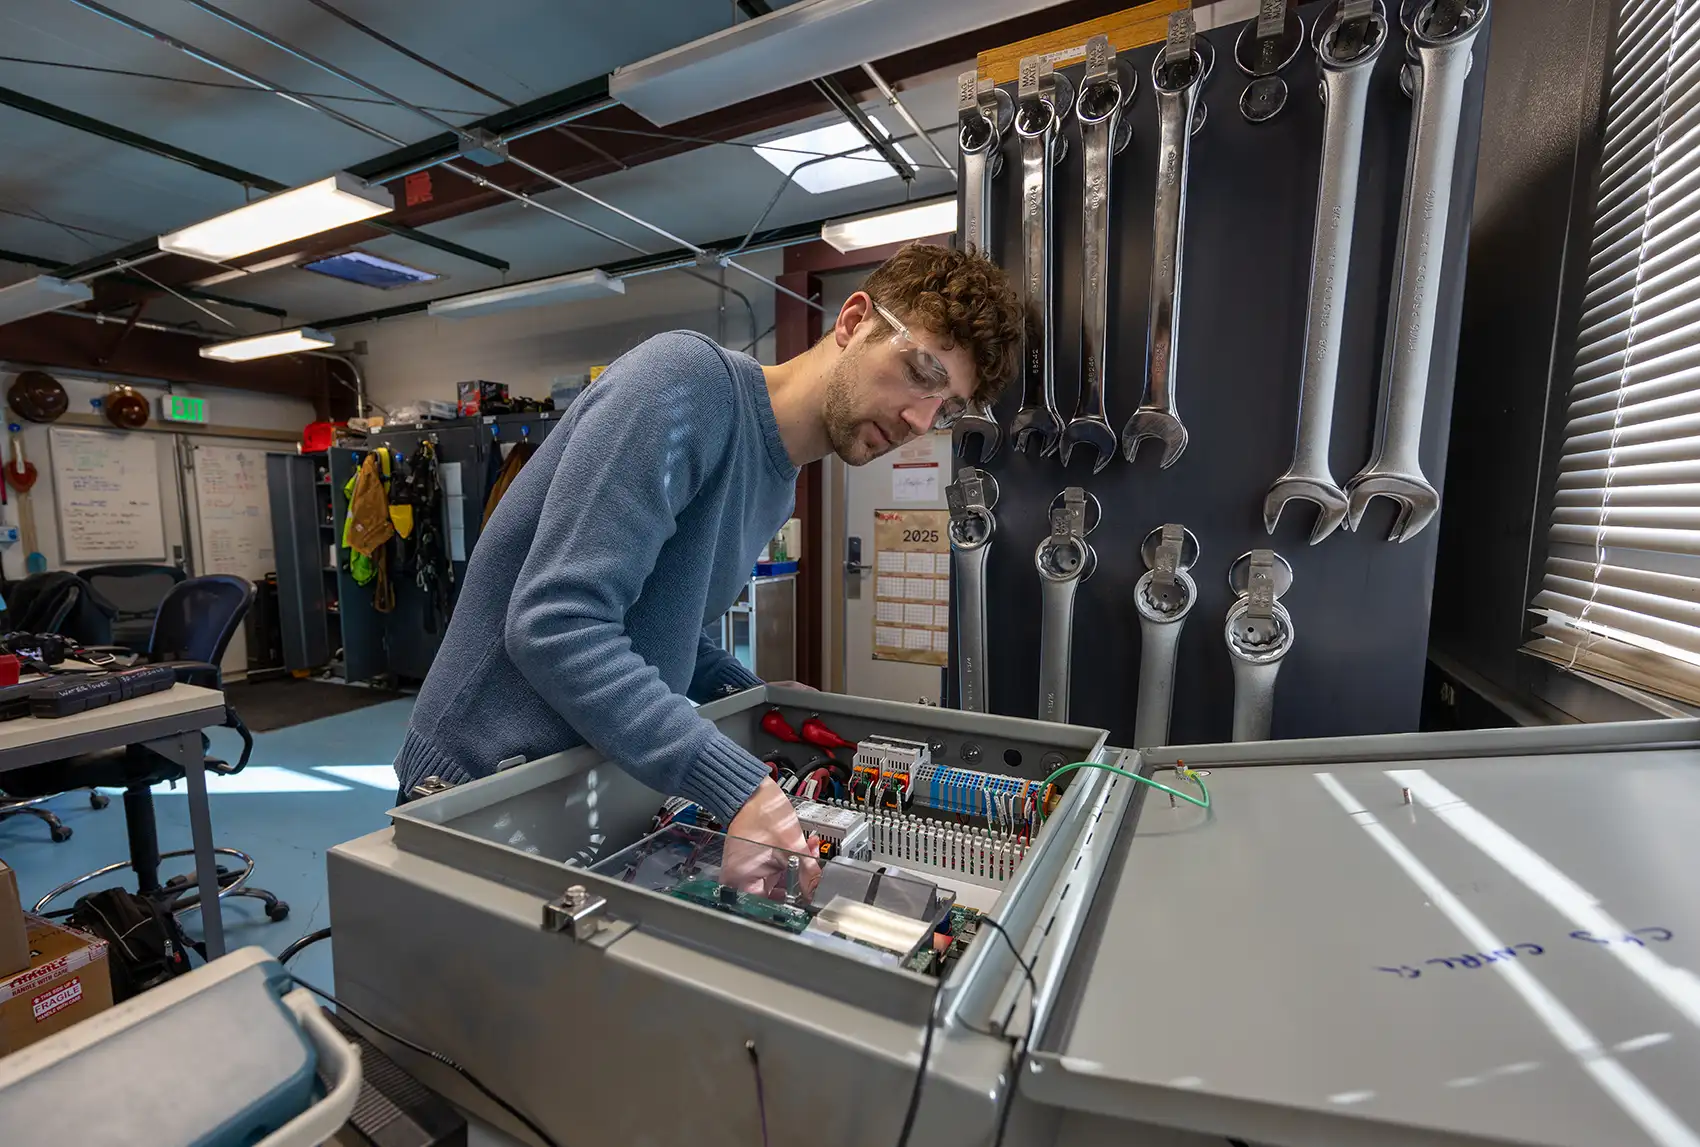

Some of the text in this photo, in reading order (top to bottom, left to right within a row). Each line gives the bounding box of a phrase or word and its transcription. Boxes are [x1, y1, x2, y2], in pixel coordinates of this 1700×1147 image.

[1171, 23, 1179, 45] MAG
[1029, 62, 1037, 86] MATE
[171, 395, 204, 422] EXIT
[903, 530, 939, 543] 2025
[58, 685, 88, 697] WATER
[12, 968, 68, 997] HANDLE WITH CARE
[40, 991, 52, 1000] THIS
[64, 981, 72, 989] UP
[35, 985, 80, 1014] FRAGILE
[37, 995, 81, 1021] HANDLE WITH CARE
